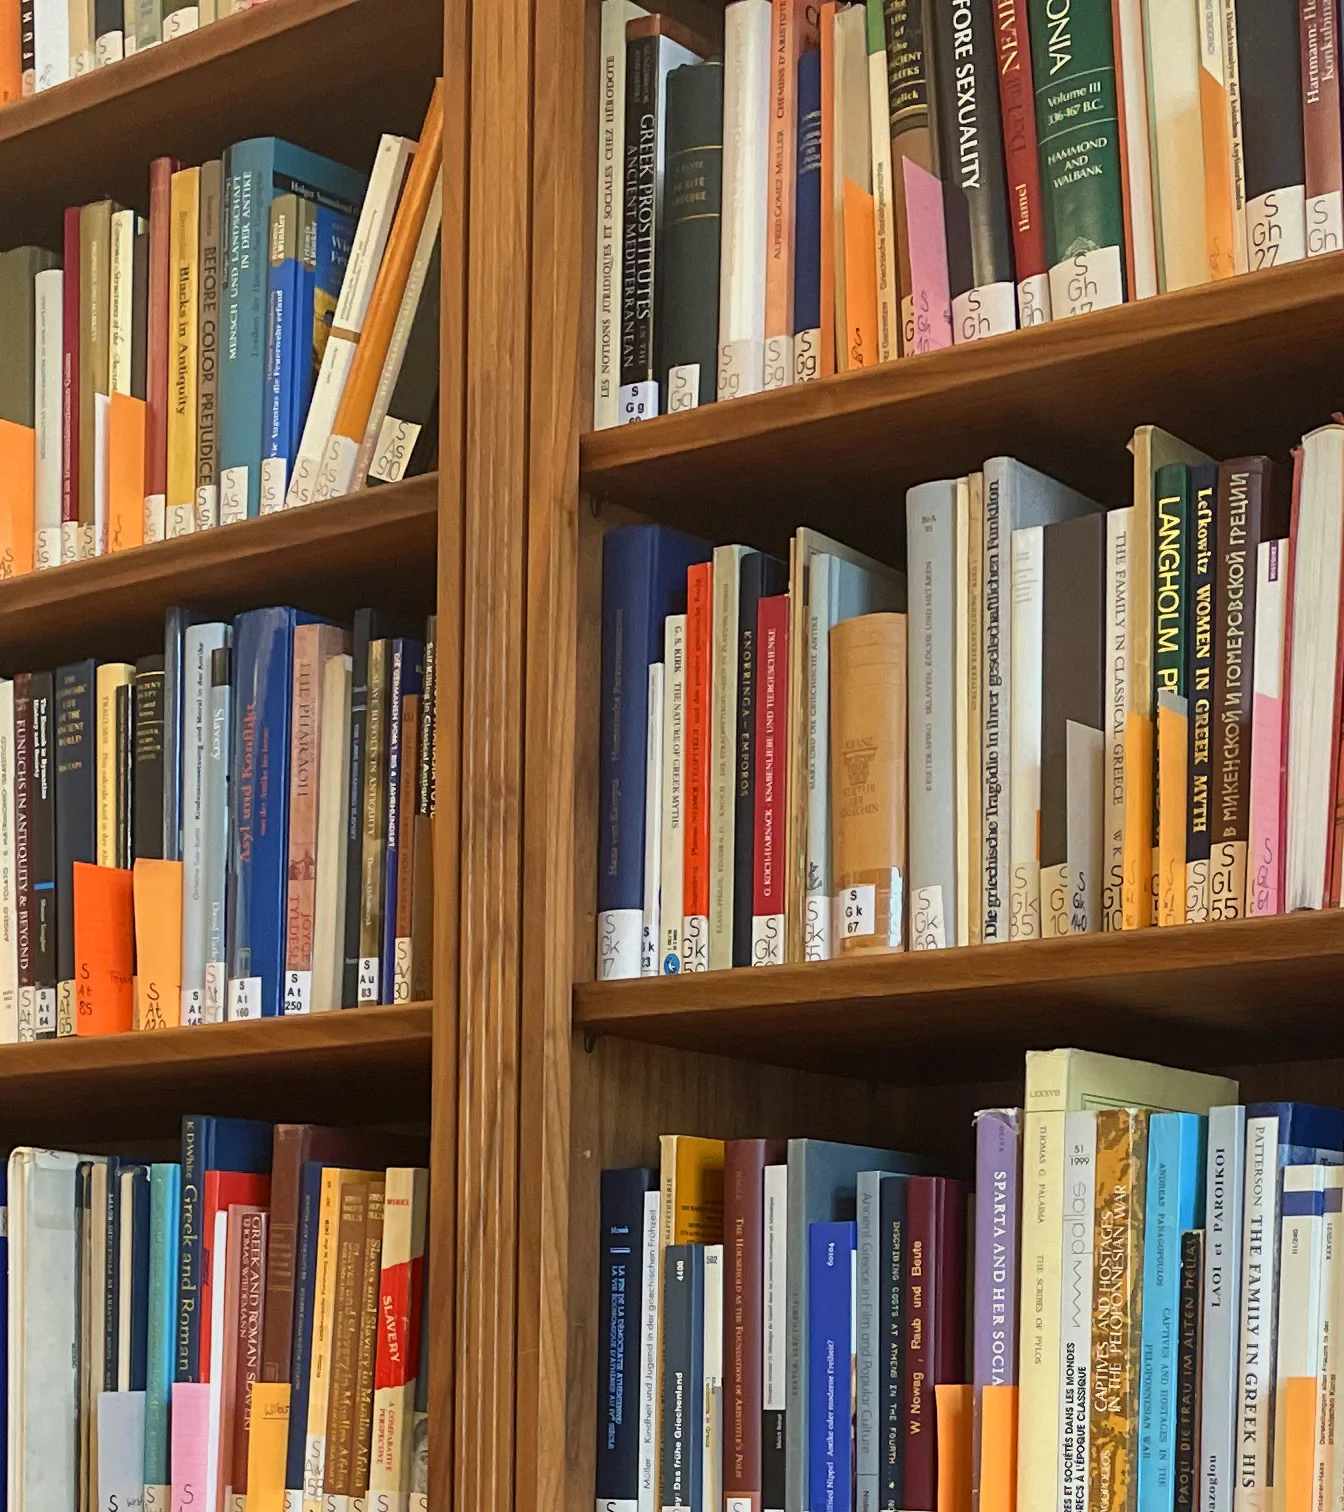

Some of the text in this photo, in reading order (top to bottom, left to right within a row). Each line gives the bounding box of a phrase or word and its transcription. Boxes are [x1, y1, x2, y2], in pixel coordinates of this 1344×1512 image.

[956, 63, 981, 189] SEXUALITY
[1047, 81, 1101, 108] Volume III
[1047, 137, 1108, 165] HAMMOND
[1053, 164, 1103, 188] WALBANK
[1064, 155, 1089, 170] AND
[634, 114, 654, 321] GREEK PROSTITUTES
[1015, 183, 1030, 232] Hamel
[179, 266, 190, 318] Blacks
[622, 145, 636, 369] ANCIENT MEDITERRANEAN
[176, 337, 188, 416] Antiquity
[199, 246, 217, 484] BEFORE COLOR PREJUDICE
[986, 479, 1000, 551] Funktion
[1157, 496, 1181, 653] LANGHOLM
[1192, 487, 1213, 833] Lefkowitz WOMEN IN GREEK MYTH
[1222, 471, 1249, 820] ГРЕЦИИ ГОМЕРОВСКОЙ И МИКЕНСКОЙ
[985, 690, 1001, 736] ihrer
[985, 737, 1000, 748] in
[985, 750, 1002, 822] Tragödie
[984, 822, 1001, 908] griechische
[984, 908, 1001, 940] Die
[992, 1170, 1007, 1283] SPARTA AND
[1094, 1210, 1114, 1413] CAPTIVES AND HOSTAGES
[1108, 1184, 1127, 1413] IN THE PELOPONNESIAN WAR
[1243, 1126, 1266, 1443] PATTERSON THE FAMILY IN GREEK
[382, 1294, 401, 1363] SLAVERY
